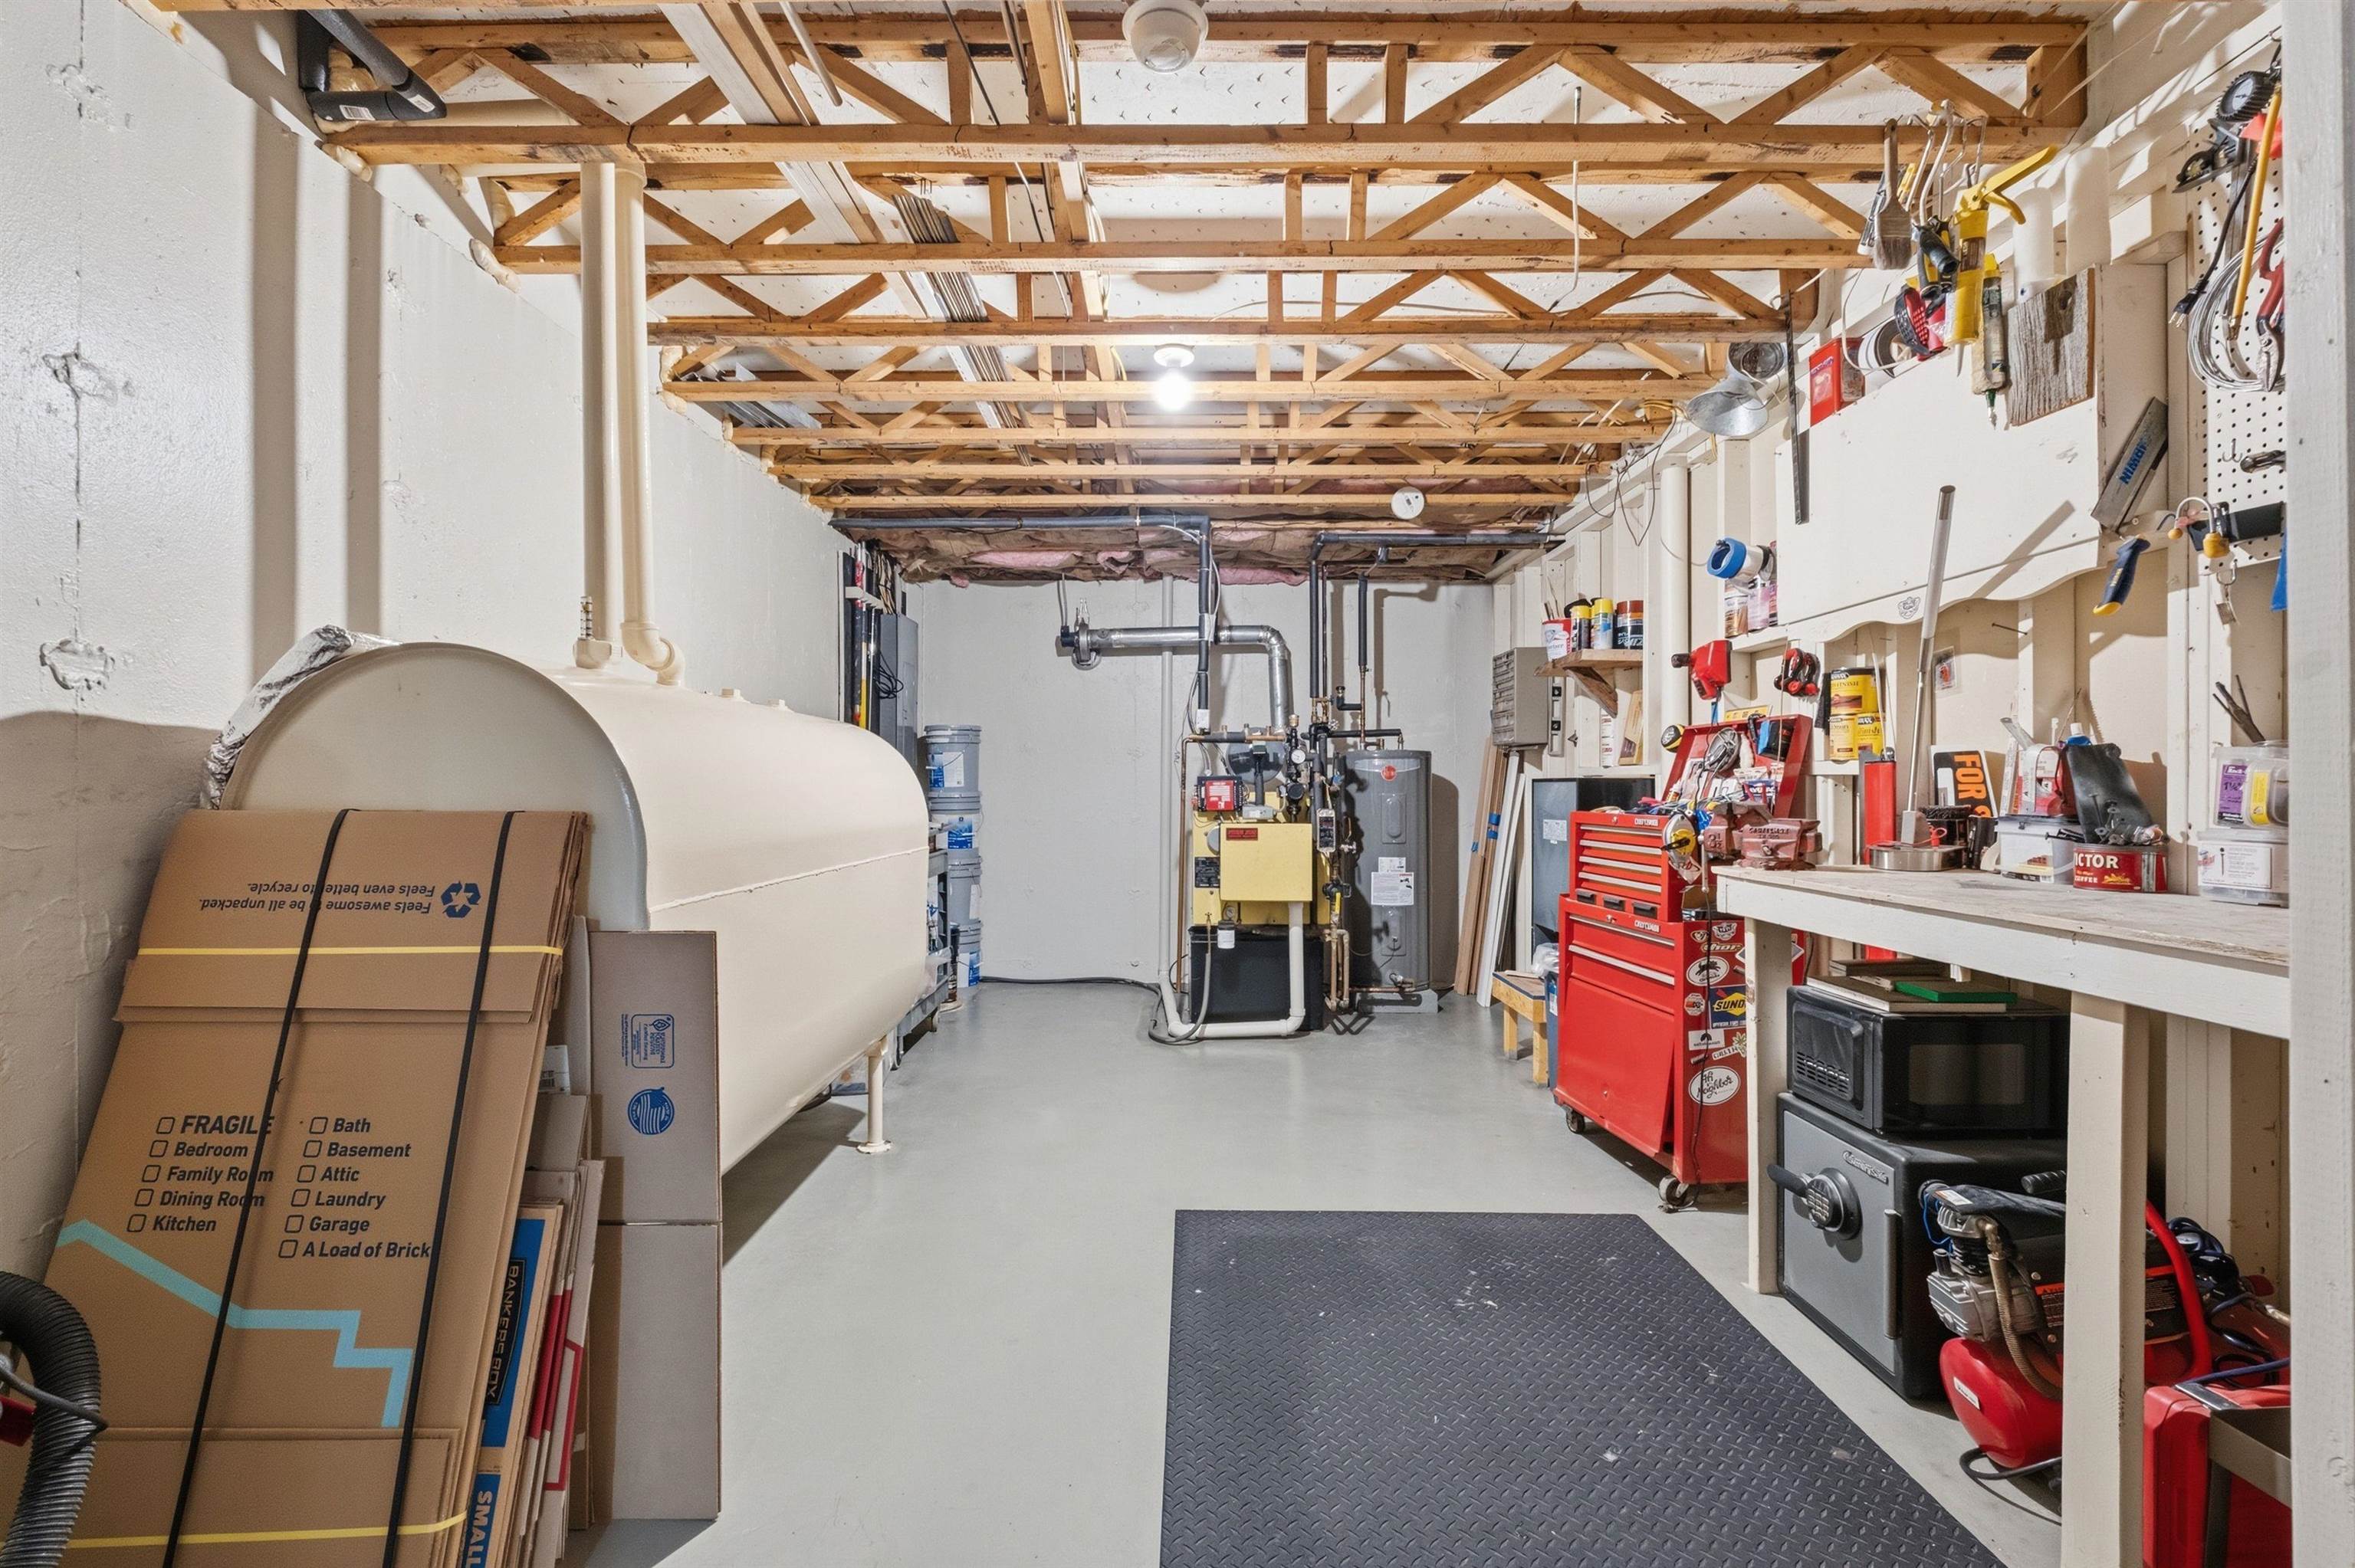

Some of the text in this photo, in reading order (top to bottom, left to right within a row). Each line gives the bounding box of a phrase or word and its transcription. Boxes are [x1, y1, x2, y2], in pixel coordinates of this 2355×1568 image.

[1954, 754, 1987, 799] FOR
[247, 881, 299, 893] recycle.
[324, 884, 360, 896] bette
[363, 884, 396, 895] even
[399, 884, 435, 897] Feels
[199, 898, 266, 910] unpacked.
[268, 899, 286, 910] all
[290, 899, 306, 910] be
[326, 900, 389, 911] awesome
[395, 900, 432, 914] Feels
[1715, 999, 1746, 1011] SUNO
[333, 1117, 371, 1133] Bath
[174, 1142, 248, 1157] Bedroom
[327, 1142, 412, 1157] Basement
[167, 1166, 274, 1185] Family Rom
[320, 1166, 360, 1182] Attic
[159, 1191, 214, 1210] Dining
[314, 1191, 386, 1210] Laundry
[153, 1215, 216, 1232] Kitchen
[309, 1215, 370, 1235] Garage
[302, 1242, 315, 1257] A
[318, 1242, 362, 1258] Load
[364, 1242, 383, 1258] of
[487, 1265, 519, 1398] BANKERS BOX
[465, 1490, 493, 1568] SMALL
